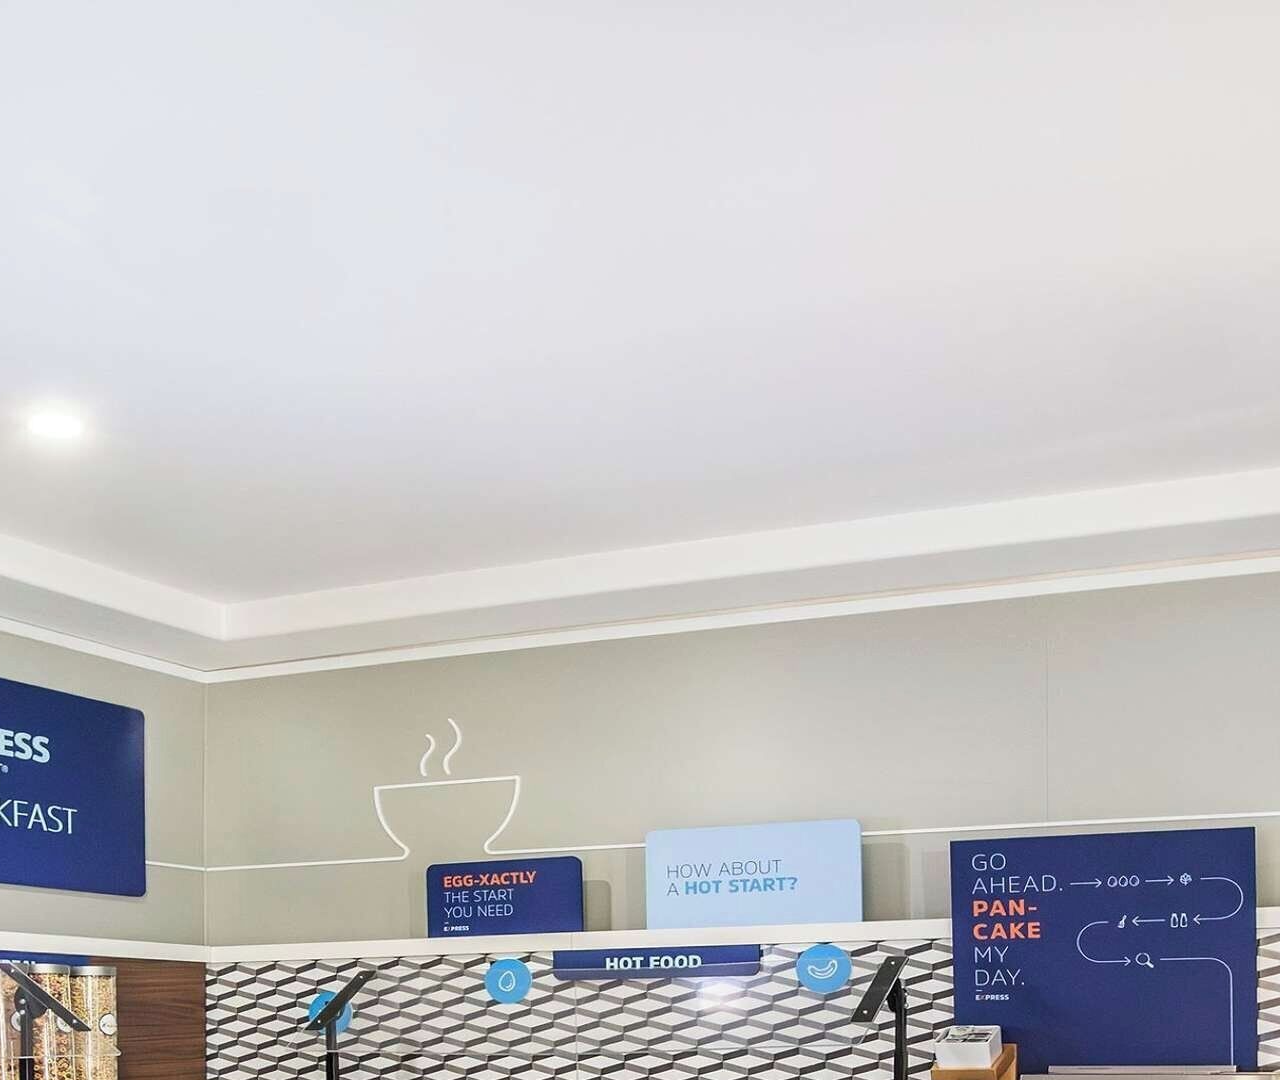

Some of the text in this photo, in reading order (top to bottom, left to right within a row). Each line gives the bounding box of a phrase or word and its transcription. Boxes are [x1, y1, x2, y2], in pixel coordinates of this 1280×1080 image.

[667, 858, 782, 879] HOW ABOUT
[971, 852, 1007, 871] GO
[443, 870, 537, 888] EGG-XACTLY
[666, 876, 798, 896] A HOT START?
[971, 874, 1064, 895] AHEAD.
[443, 888, 514, 903] THE START
[443, 903, 514, 918] YOU NEED
[972, 898, 1038, 917] PAN-
[972, 921, 1042, 941] CAKE
[605, 954, 703, 970] HOT FOOD
[974, 945, 1009, 963] MY
[974, 968, 1025, 986] DAY.
